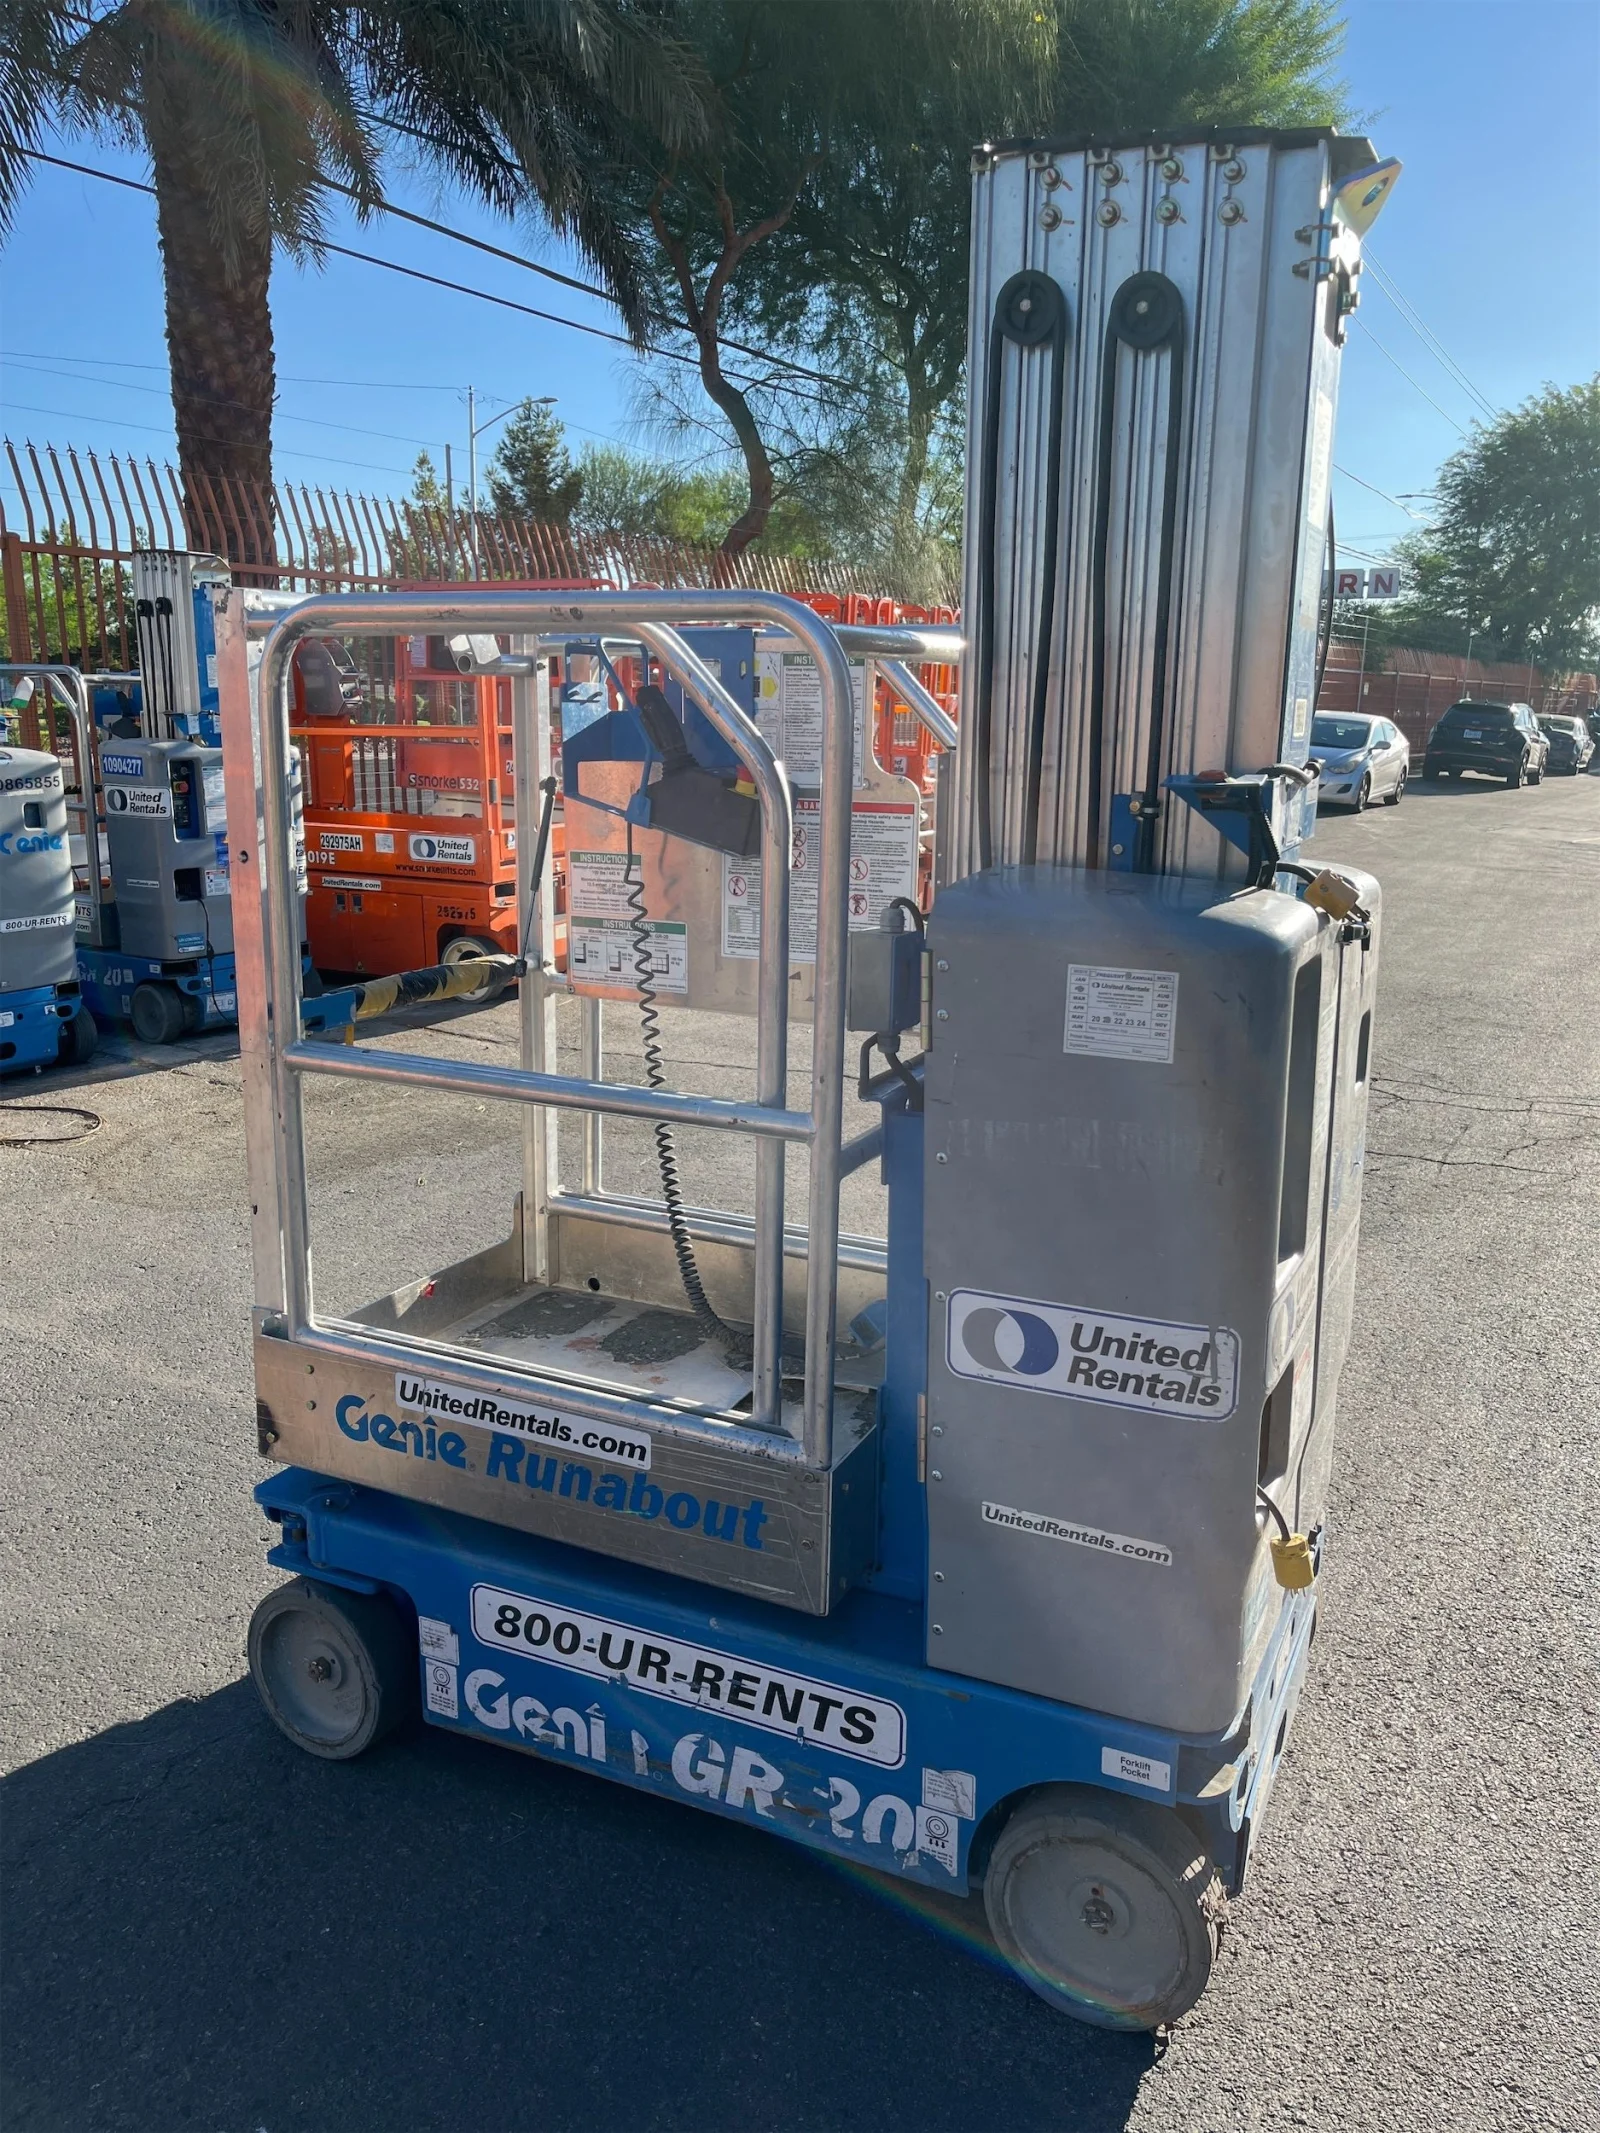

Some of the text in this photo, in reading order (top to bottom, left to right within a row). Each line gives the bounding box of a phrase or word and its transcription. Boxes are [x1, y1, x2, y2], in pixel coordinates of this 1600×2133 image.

[103, 757, 142, 775] 10904277
[129, 790, 163, 803] United
[130, 802, 167, 814] Rentals
[320, 834, 362, 850] 292975AH
[437, 839, 469, 851] United
[437, 850, 472, 861] Rentals
[5, 915, 67, 930] 800-UR-RENTS
[1100, 981, 1152, 993] United Rentals
[1091, 1015, 1101, 1023] 20
[1114, 1017, 1124, 1025] 22
[1125, 1018, 1135, 1026] 23
[1136, 1019, 1146, 1027] 24
[1069, 1321, 1211, 1373] United
[1066, 1354, 1223, 1408] Rentals
[399, 1379, 648, 1463] UnitedRentals.com
[335, 1393, 768, 1550] Genie Runabout
[984, 1503, 1170, 1563] UnitedRentals.com
[493, 1603, 878, 1746] 800-UR-RENTS
[1120, 1756, 1151, 1772] Forklift
[1120, 1765, 1150, 1780] Pocket
